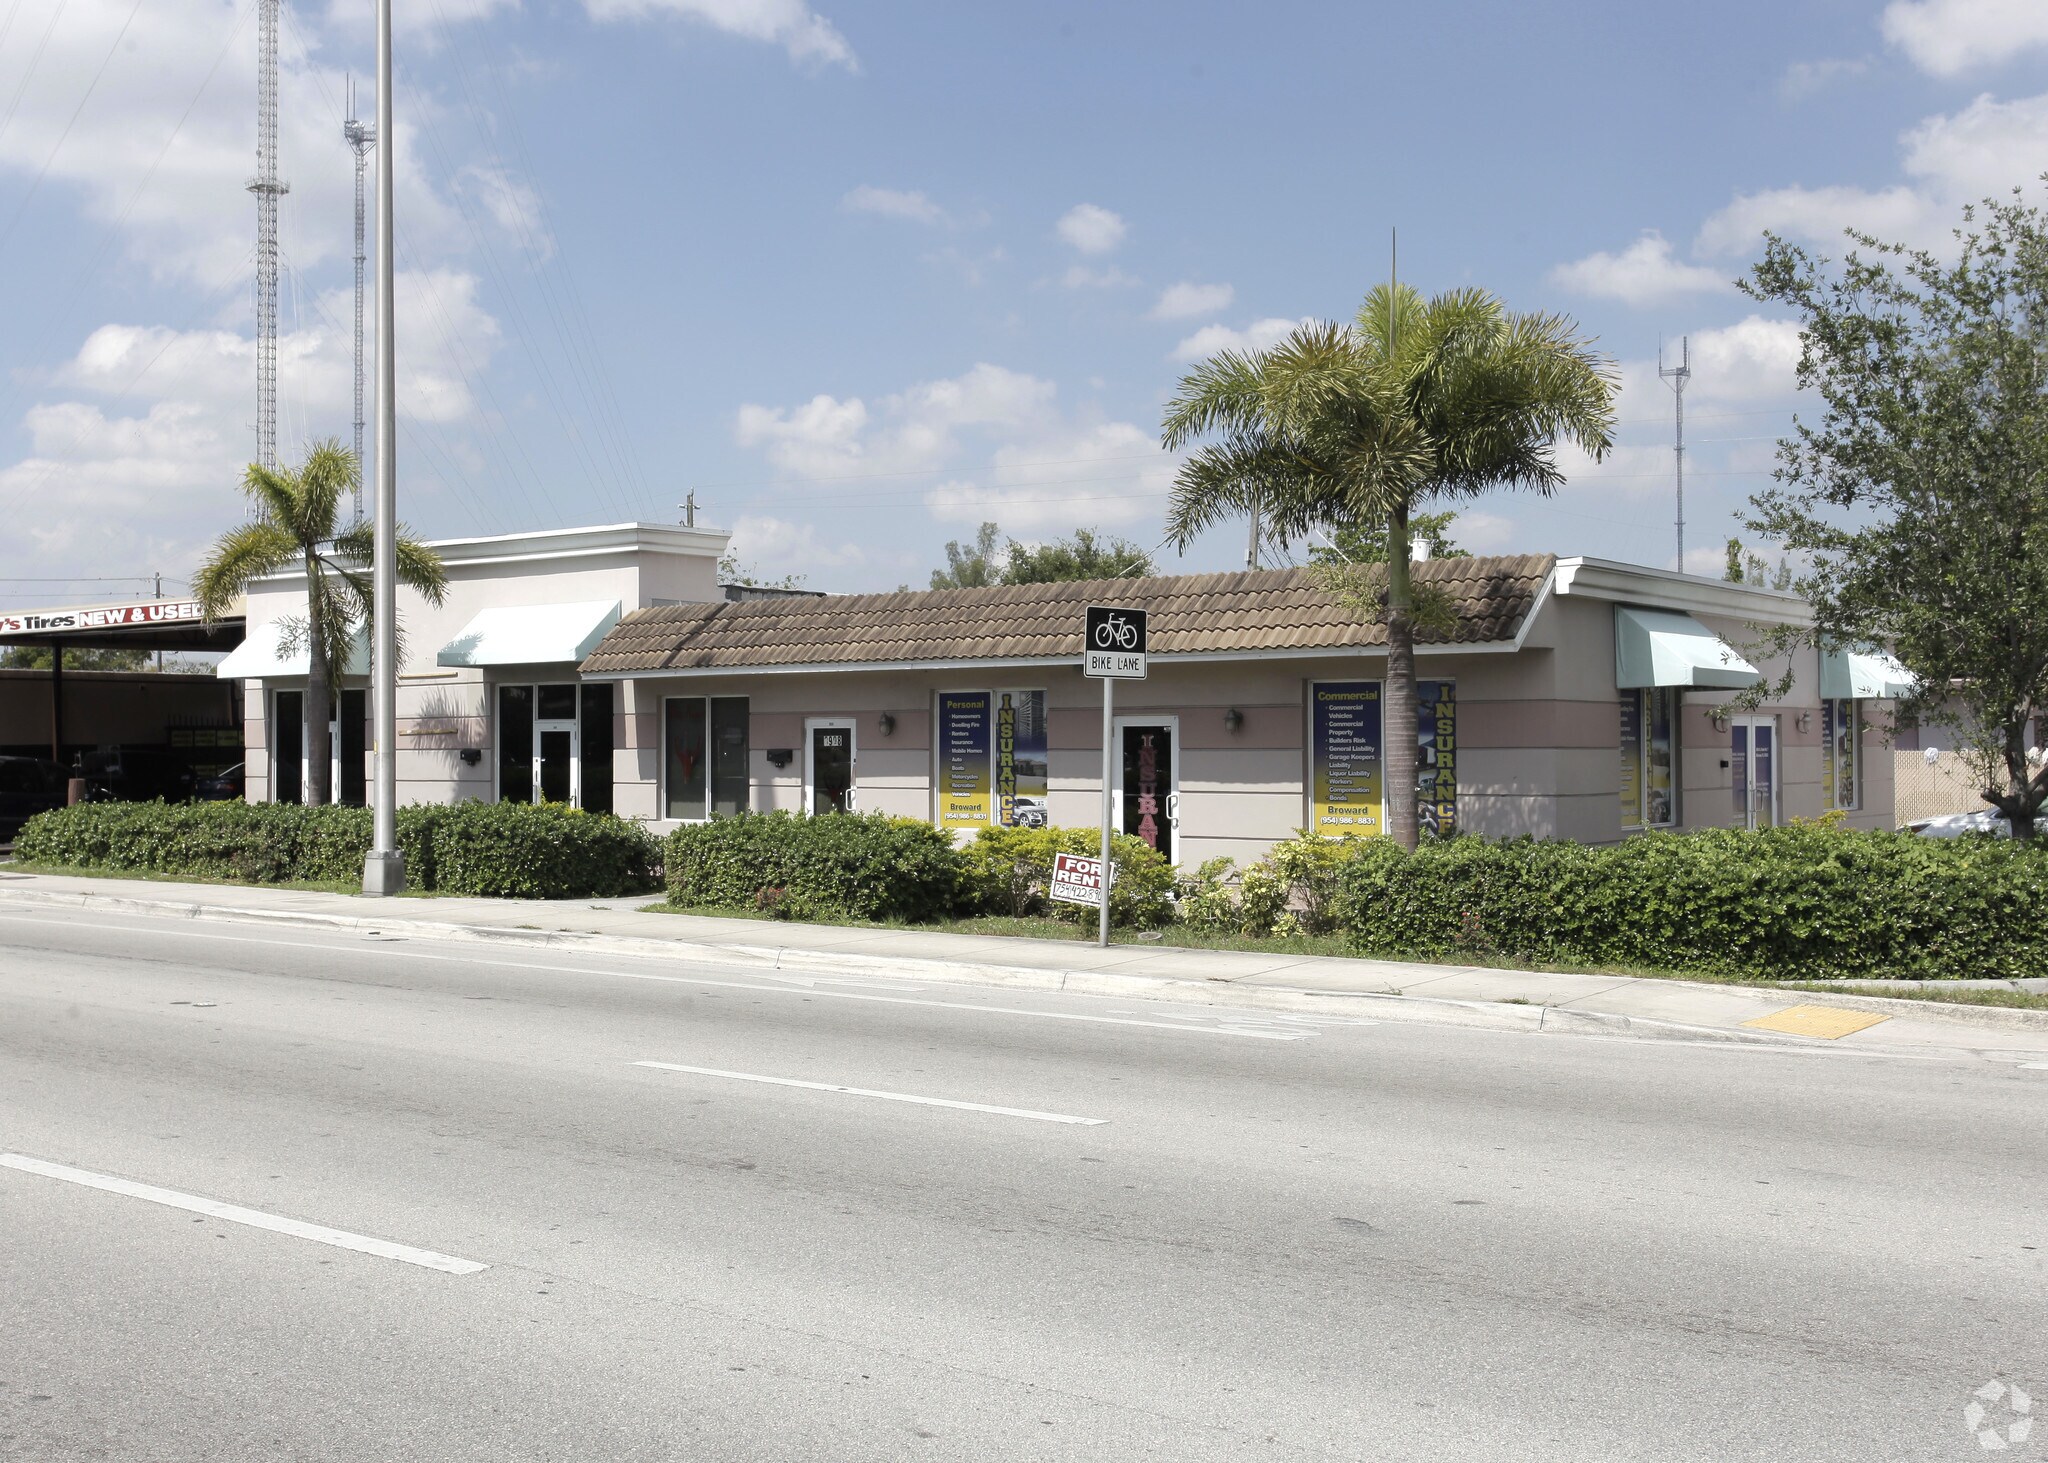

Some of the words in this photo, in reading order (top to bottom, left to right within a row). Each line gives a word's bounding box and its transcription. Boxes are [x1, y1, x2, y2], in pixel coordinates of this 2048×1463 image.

[24, 616, 75, 629] Tires
[80, 608, 126, 627] NEW
[131, 607, 145, 621] &
[1092, 656, 1112, 670] BIKE
[1118, 658, 1140, 671] LANE
[1318, 691, 1377, 701] Commercial
[947, 701, 984, 709] Personal
[1000, 694, 1015, 824] INSURANCE
[1436, 685, 1455, 834] INSURANCE
[1329, 770, 1347, 778] Liquor
[950, 803, 982, 811] Broward
[1327, 805, 1368, 815] Broward
[1320, 816, 1338, 825] (954)
[1339, 816, 1354, 825] 986
[1358, 817, 1375, 825] 8831
[1065, 858, 1102, 875] FOR
